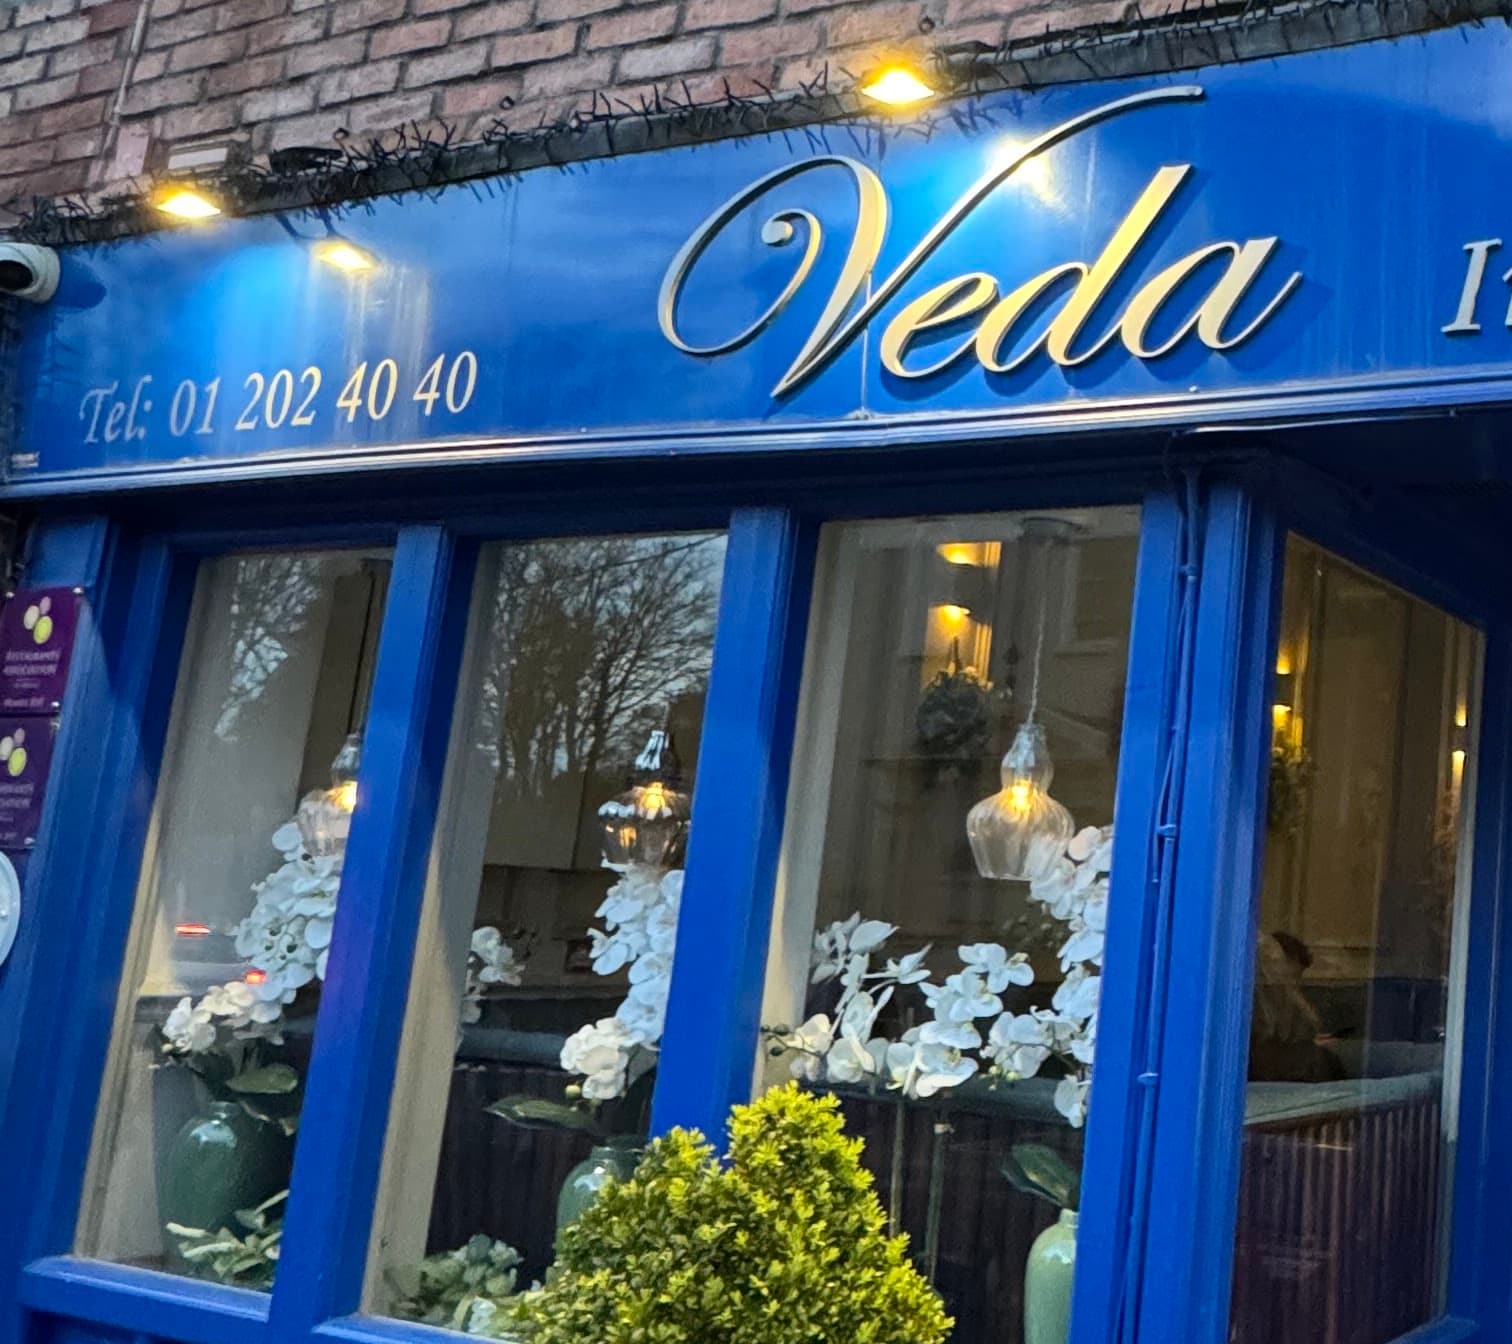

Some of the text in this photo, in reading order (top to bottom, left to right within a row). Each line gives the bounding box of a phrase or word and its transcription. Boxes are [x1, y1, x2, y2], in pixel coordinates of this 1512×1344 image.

[658, 85, 1304, 400] Veda
[79, 351, 478, 444] Tel: 01 202 40 40
